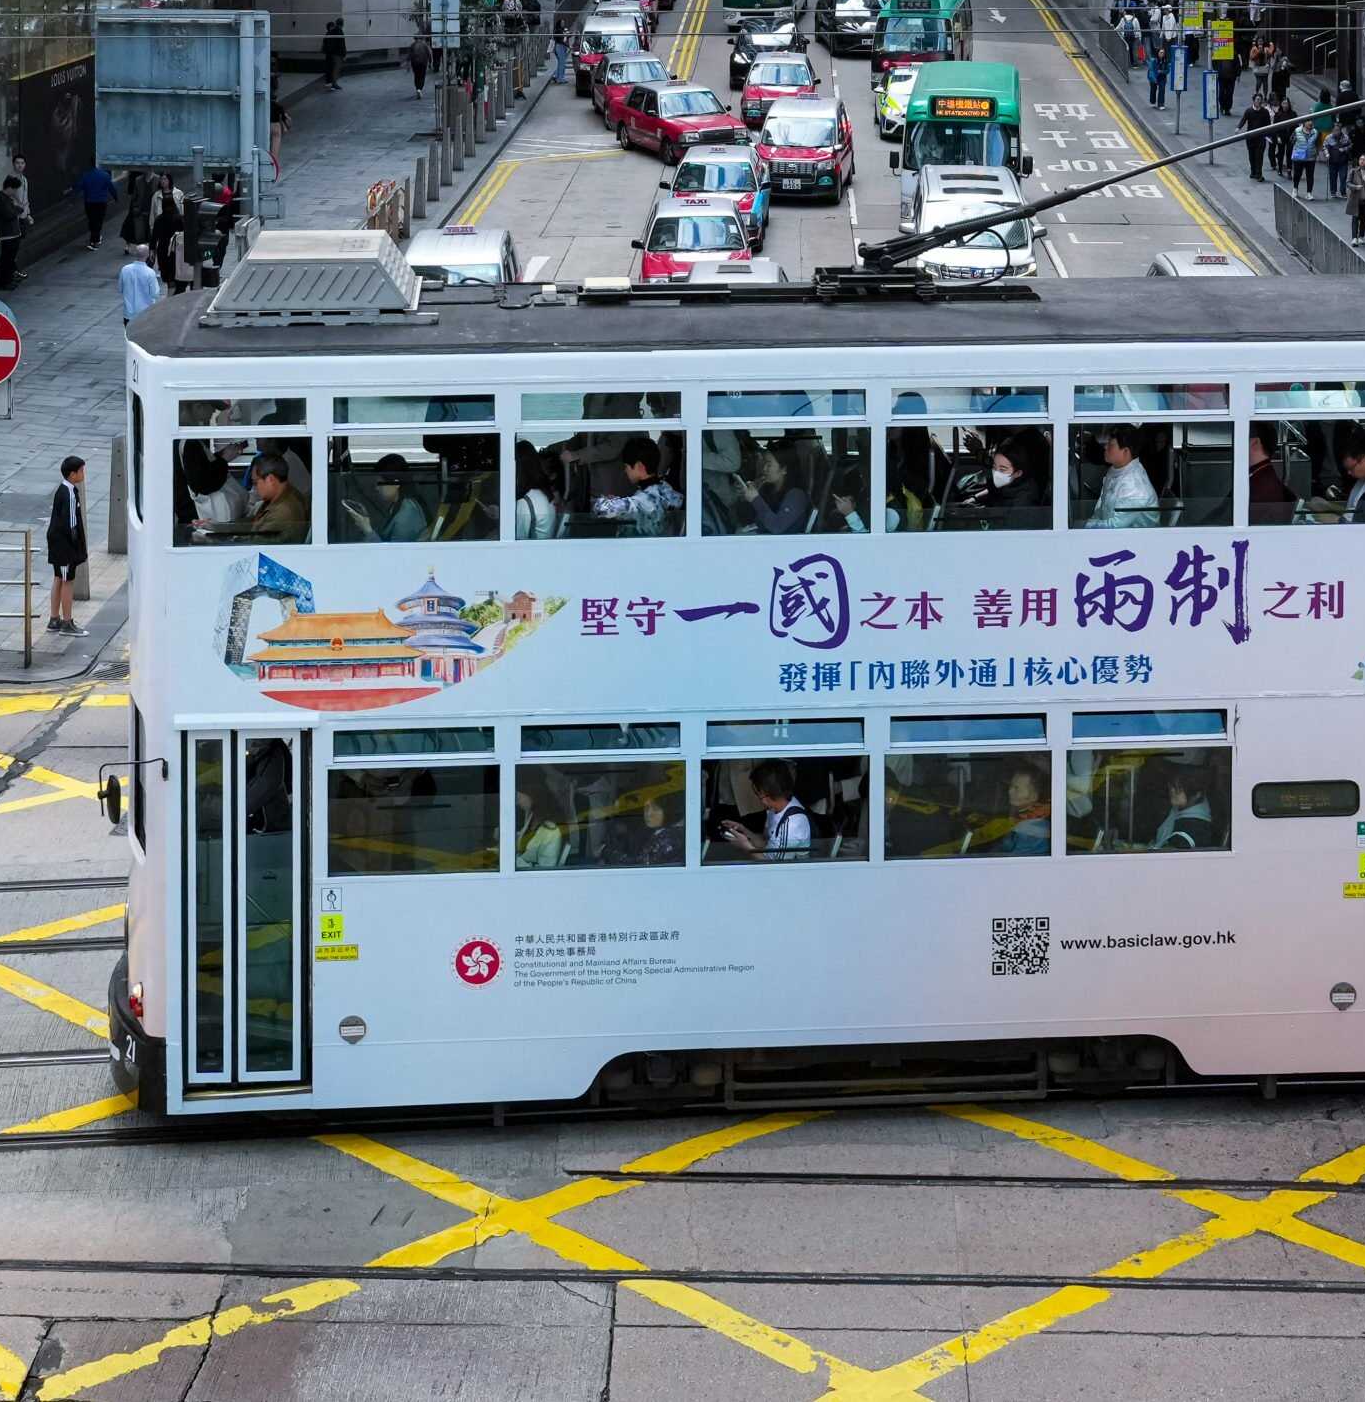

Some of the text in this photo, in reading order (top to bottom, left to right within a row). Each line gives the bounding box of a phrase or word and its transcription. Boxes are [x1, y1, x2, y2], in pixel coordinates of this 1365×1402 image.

[322, 931, 341, 939] EXIT
[514, 930, 681, 944] 中華人民共和國香港特別行政區政府
[1060, 931, 1237, 951] www.basiclaw.gov.hk
[514, 957, 677, 969] Constitutional and Mainland Affairs Bureau
[514, 963, 755, 978] The Government of the Hong Kong Special Administrative Region
[514, 976, 637, 988] of the People's Republic of China
